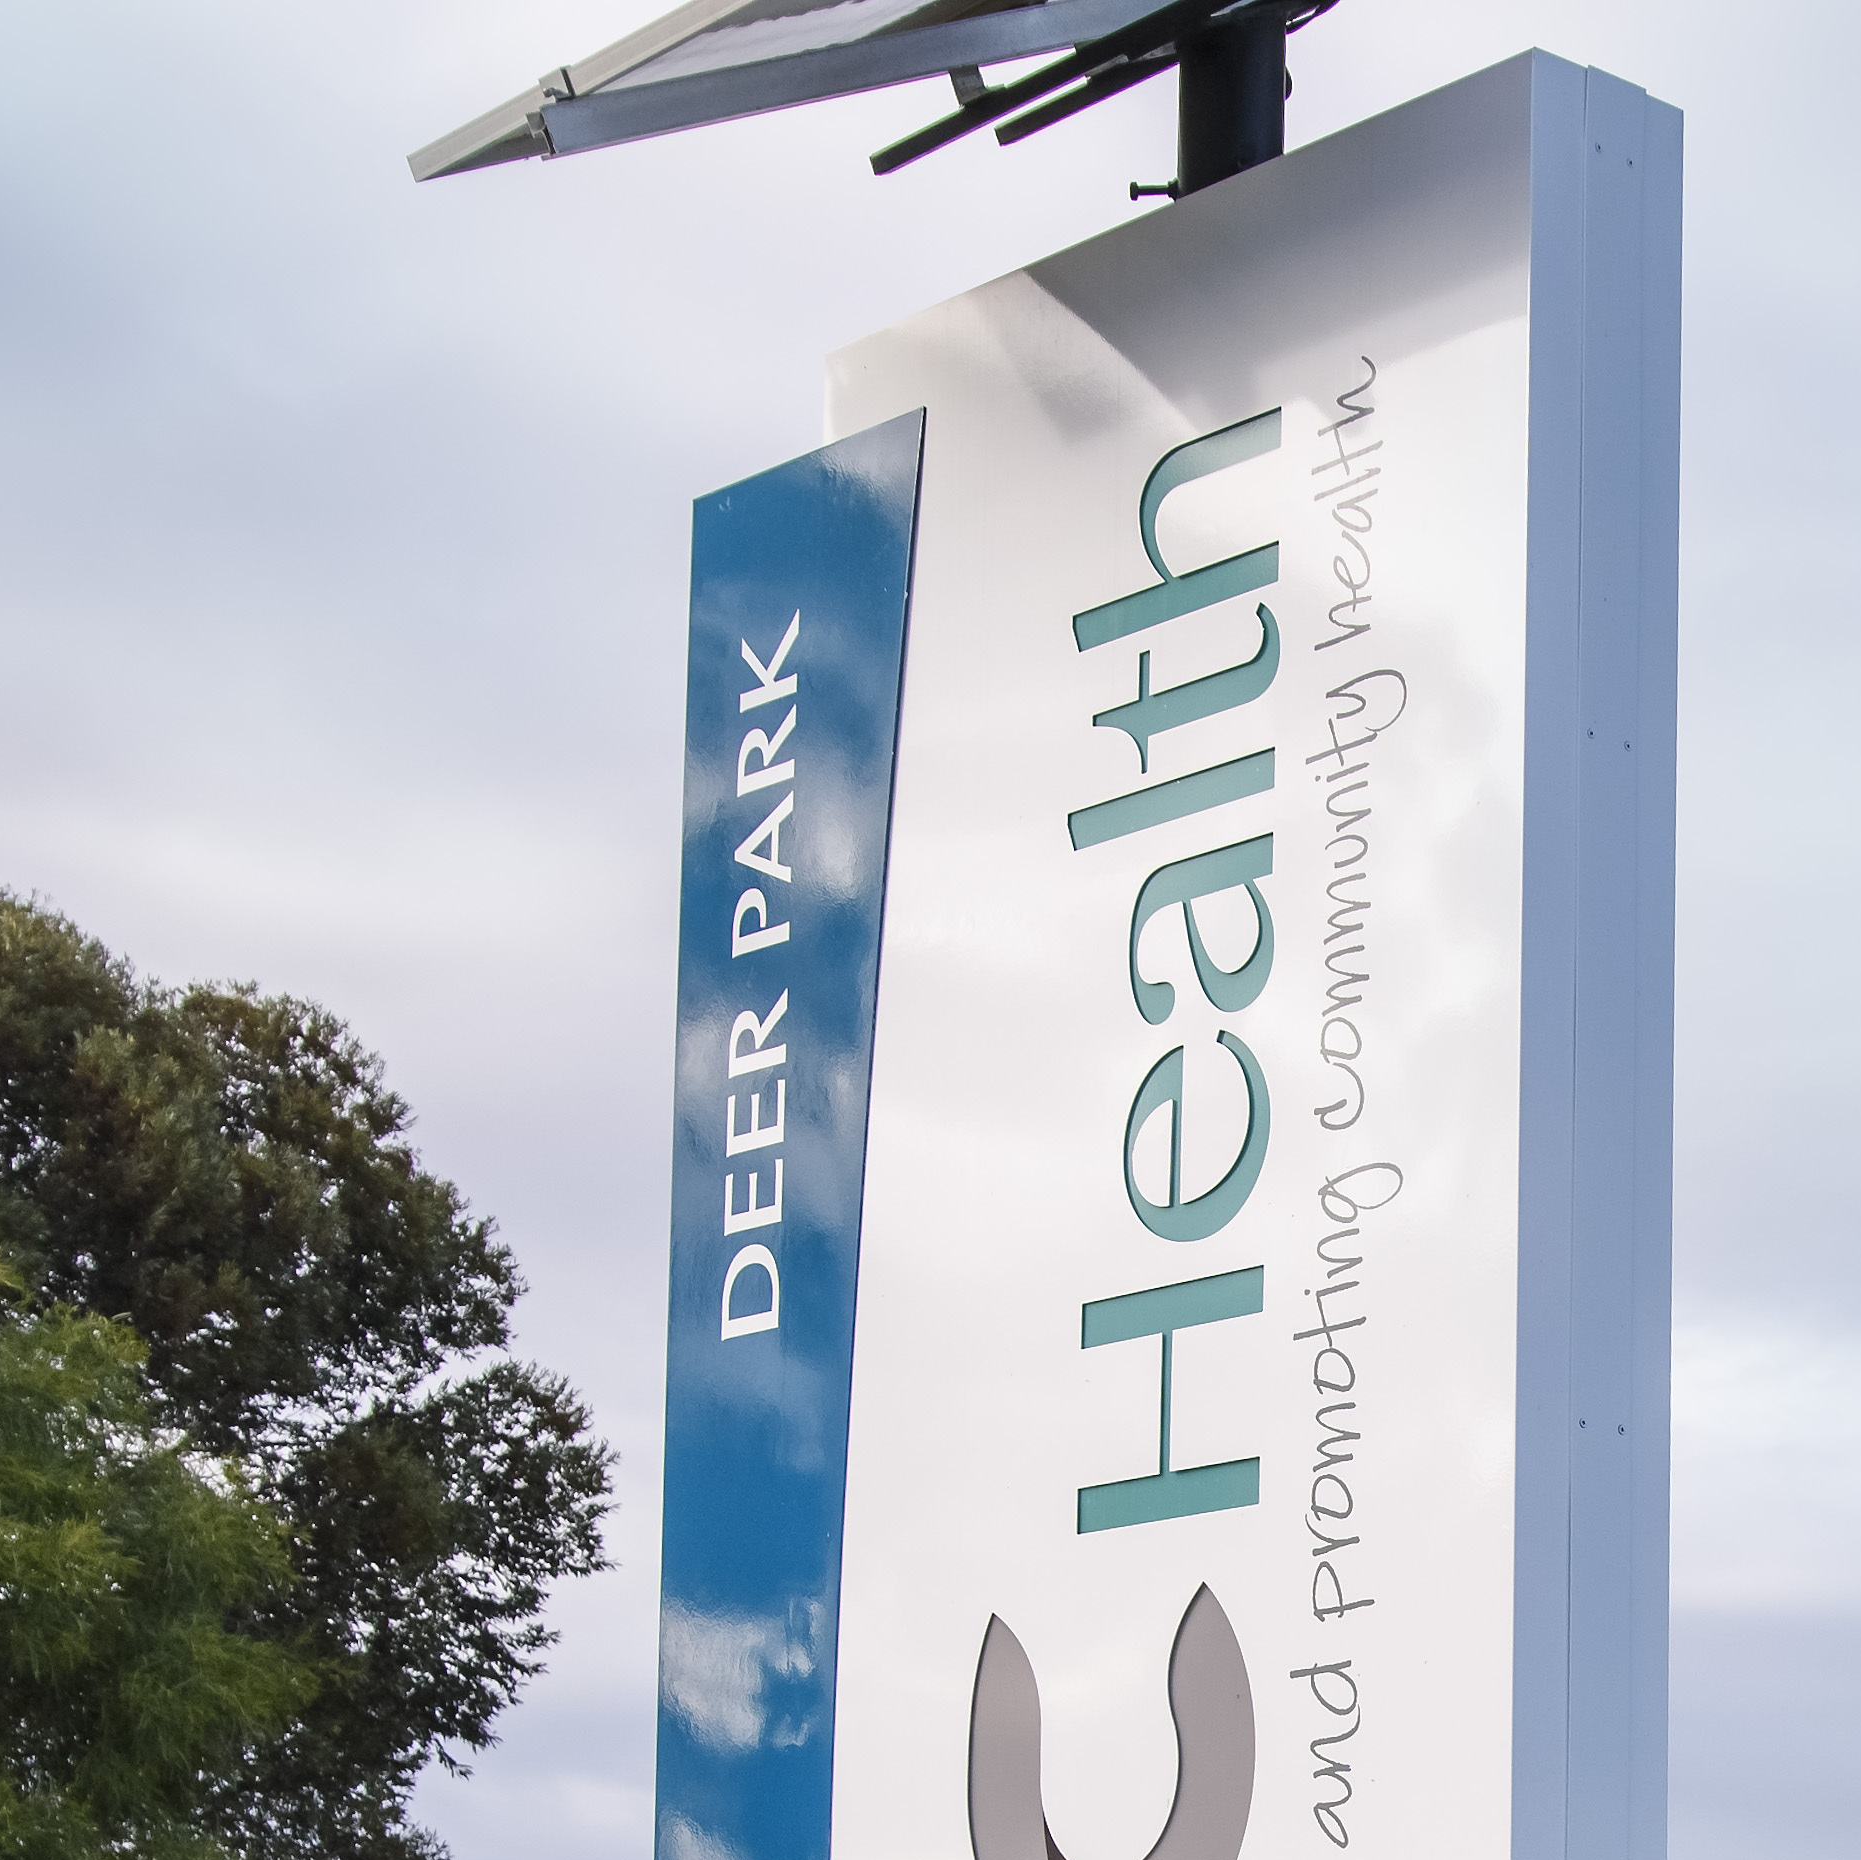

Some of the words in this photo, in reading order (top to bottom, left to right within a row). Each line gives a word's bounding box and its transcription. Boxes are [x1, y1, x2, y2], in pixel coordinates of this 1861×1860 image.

[1310, 355, 1384, 651] health
[731, 608, 800, 959] PARK
[1305, 669, 1407, 1131] community
[1067, 406, 1282, 1535] Health
[720, 988, 789, 1342] DEER
[1293, 1162, 1404, 1623] promoting
[1289, 1659, 1361, 1849] and
